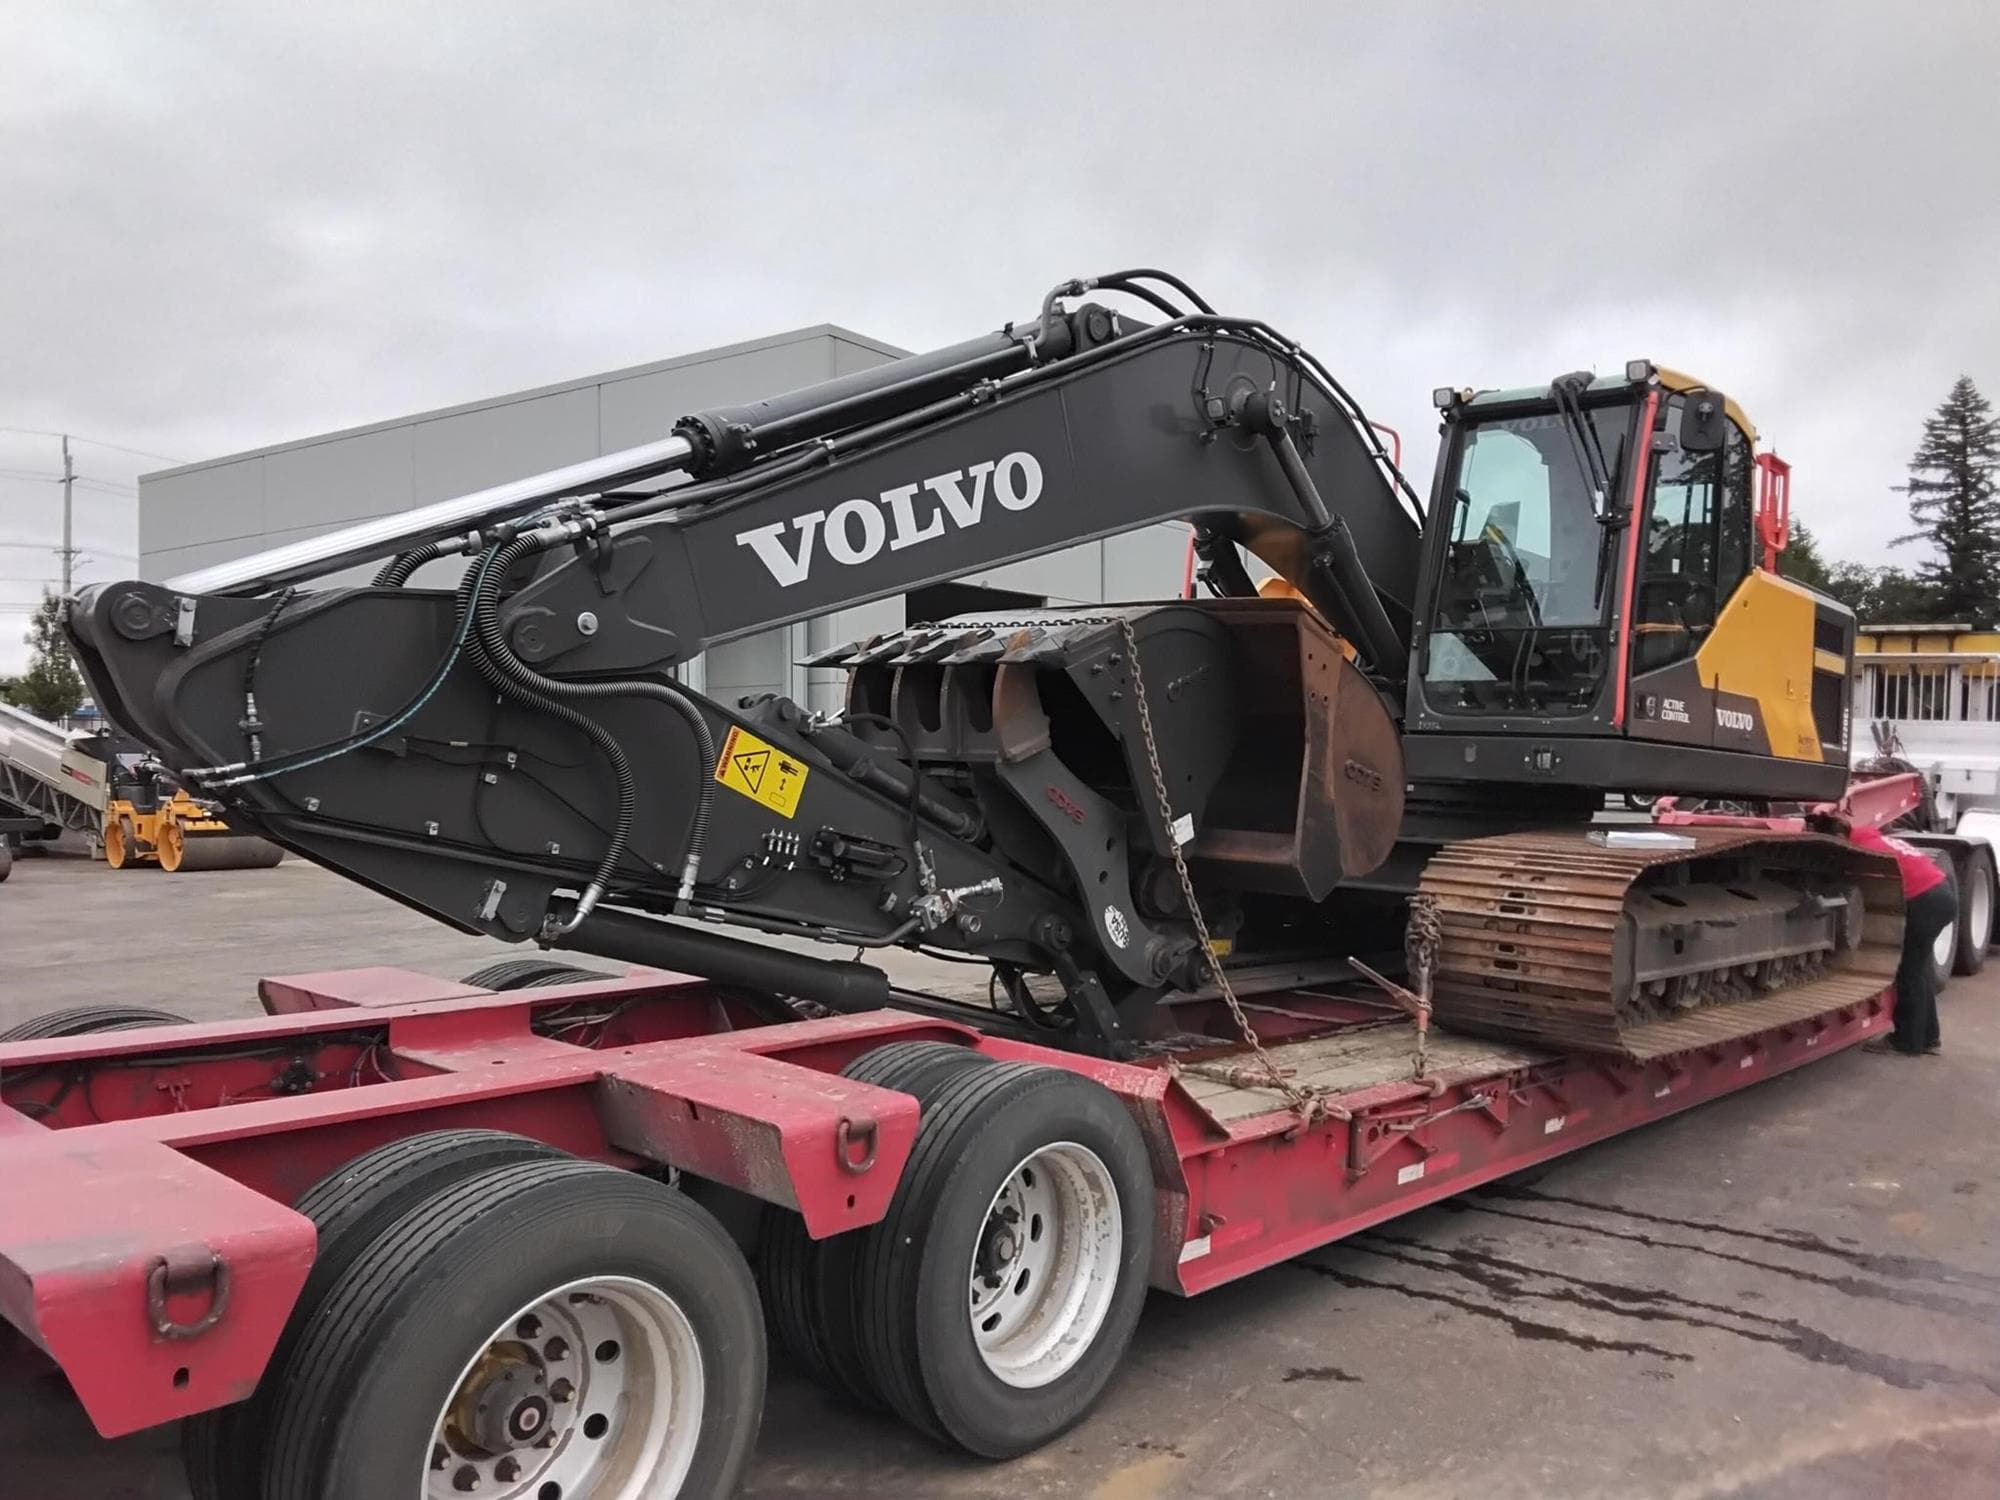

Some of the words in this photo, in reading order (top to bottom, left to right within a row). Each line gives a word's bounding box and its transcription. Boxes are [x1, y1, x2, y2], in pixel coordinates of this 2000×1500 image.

[736, 452, 1043, 587] VOLVO
[1661, 710, 1690, 723] CONTROL
[1663, 699, 1685, 711] ACTIVE
[1716, 708, 1753, 731] VOLVO
[720, 729, 739, 770] WARNING
